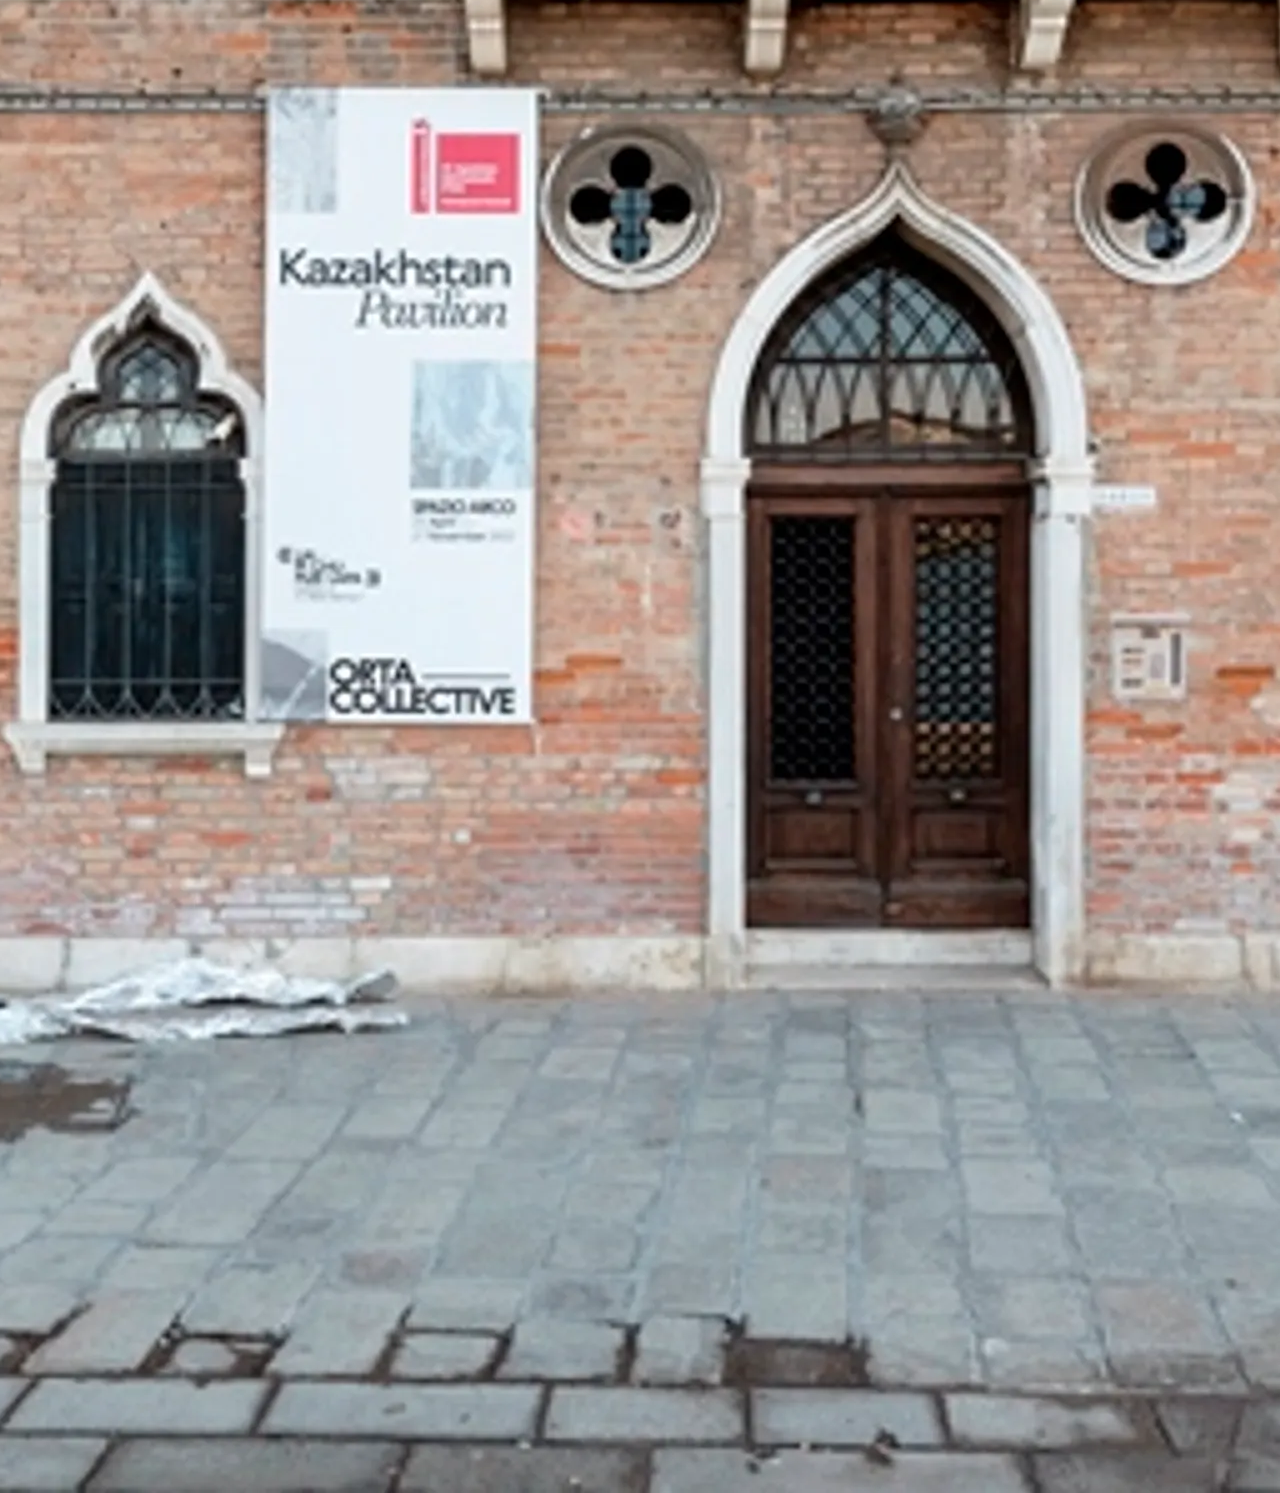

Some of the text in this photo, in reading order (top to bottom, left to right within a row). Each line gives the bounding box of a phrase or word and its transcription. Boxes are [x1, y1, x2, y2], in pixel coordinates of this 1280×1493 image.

[279, 248, 511, 287] Kazakhstan
[354, 288, 507, 329] Pavilion
[330, 658, 415, 687] ORTA
[330, 687, 516, 715] COLLECTIVE
